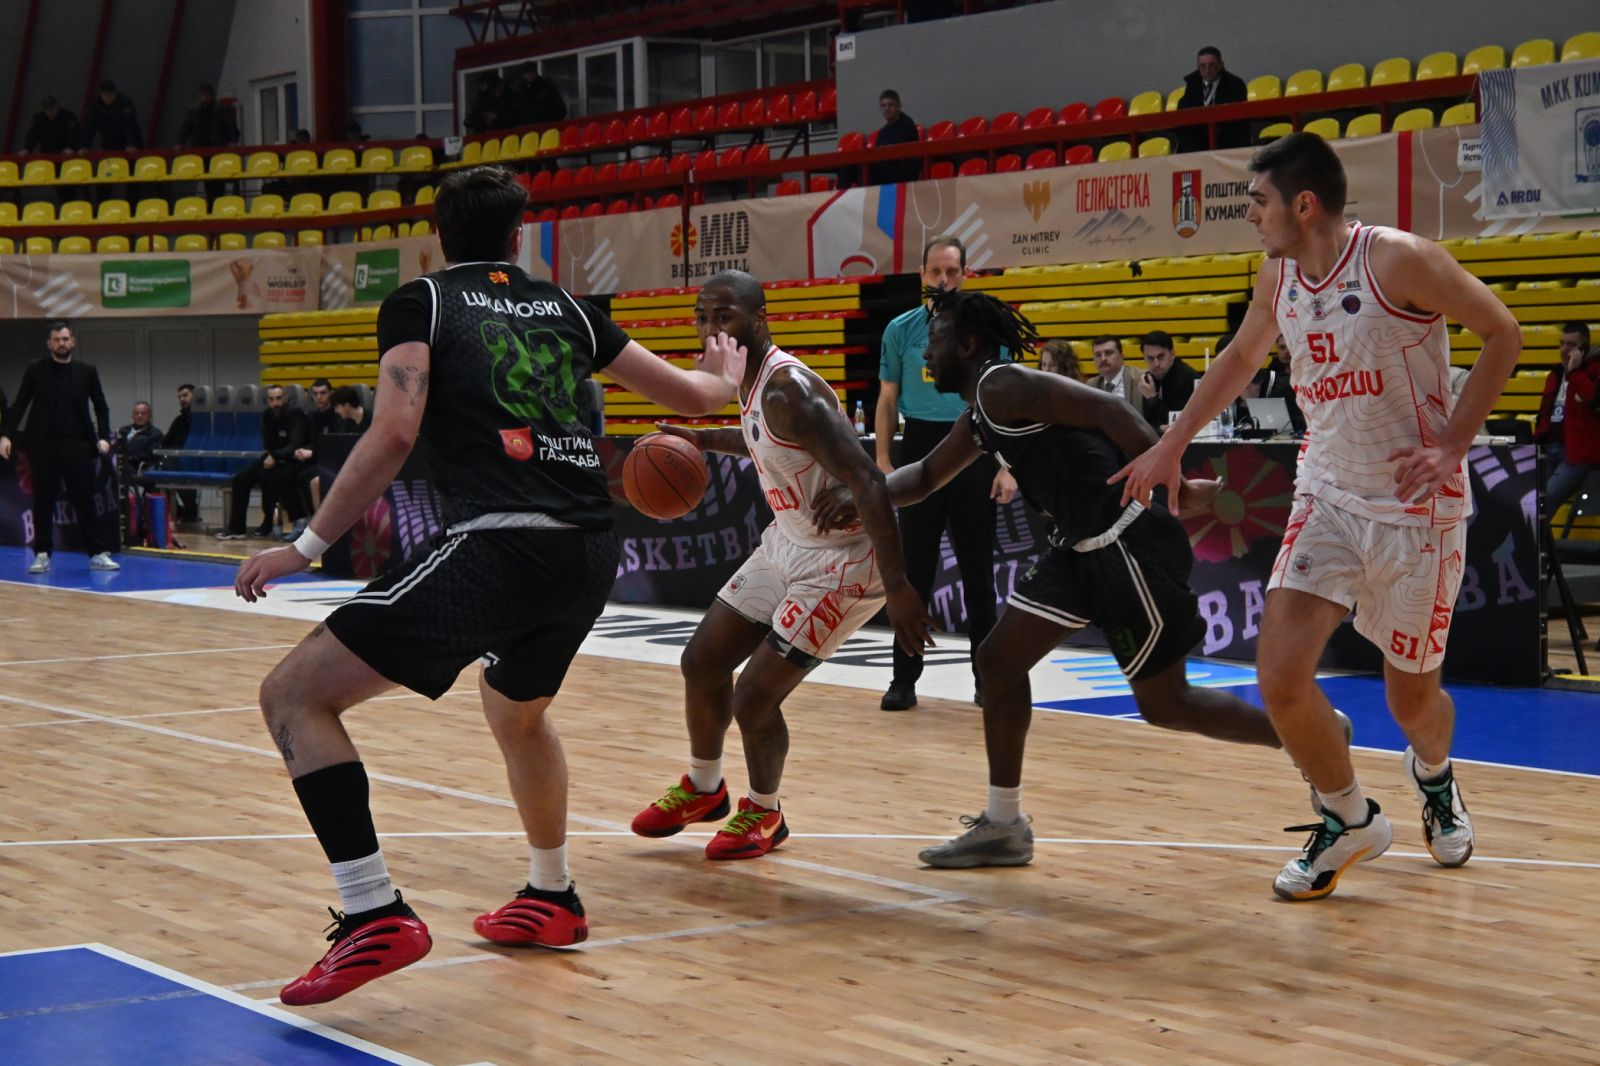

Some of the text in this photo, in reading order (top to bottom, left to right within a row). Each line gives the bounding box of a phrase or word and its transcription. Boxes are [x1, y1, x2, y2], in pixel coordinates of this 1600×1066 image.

[1541, 77, 1572, 110] MKK
[1462, 143, 1481, 152] Парт
[1076, 172, 1150, 213] ПЕЛИСТЕРКА
[1205, 181, 1250, 199] ОПШТИН
[1205, 203, 1250, 221] КУМАНО
[700, 211, 749, 258] MKD
[1030, 231, 1061, 243] MITREV
[1022, 245, 1050, 255] CLINIC
[462, 291, 563, 318] LUKANOSKI
[1307, 332, 1340, 363] 51
[781, 599, 804, 628] 15
[1390, 629, 1419, 660] 51
